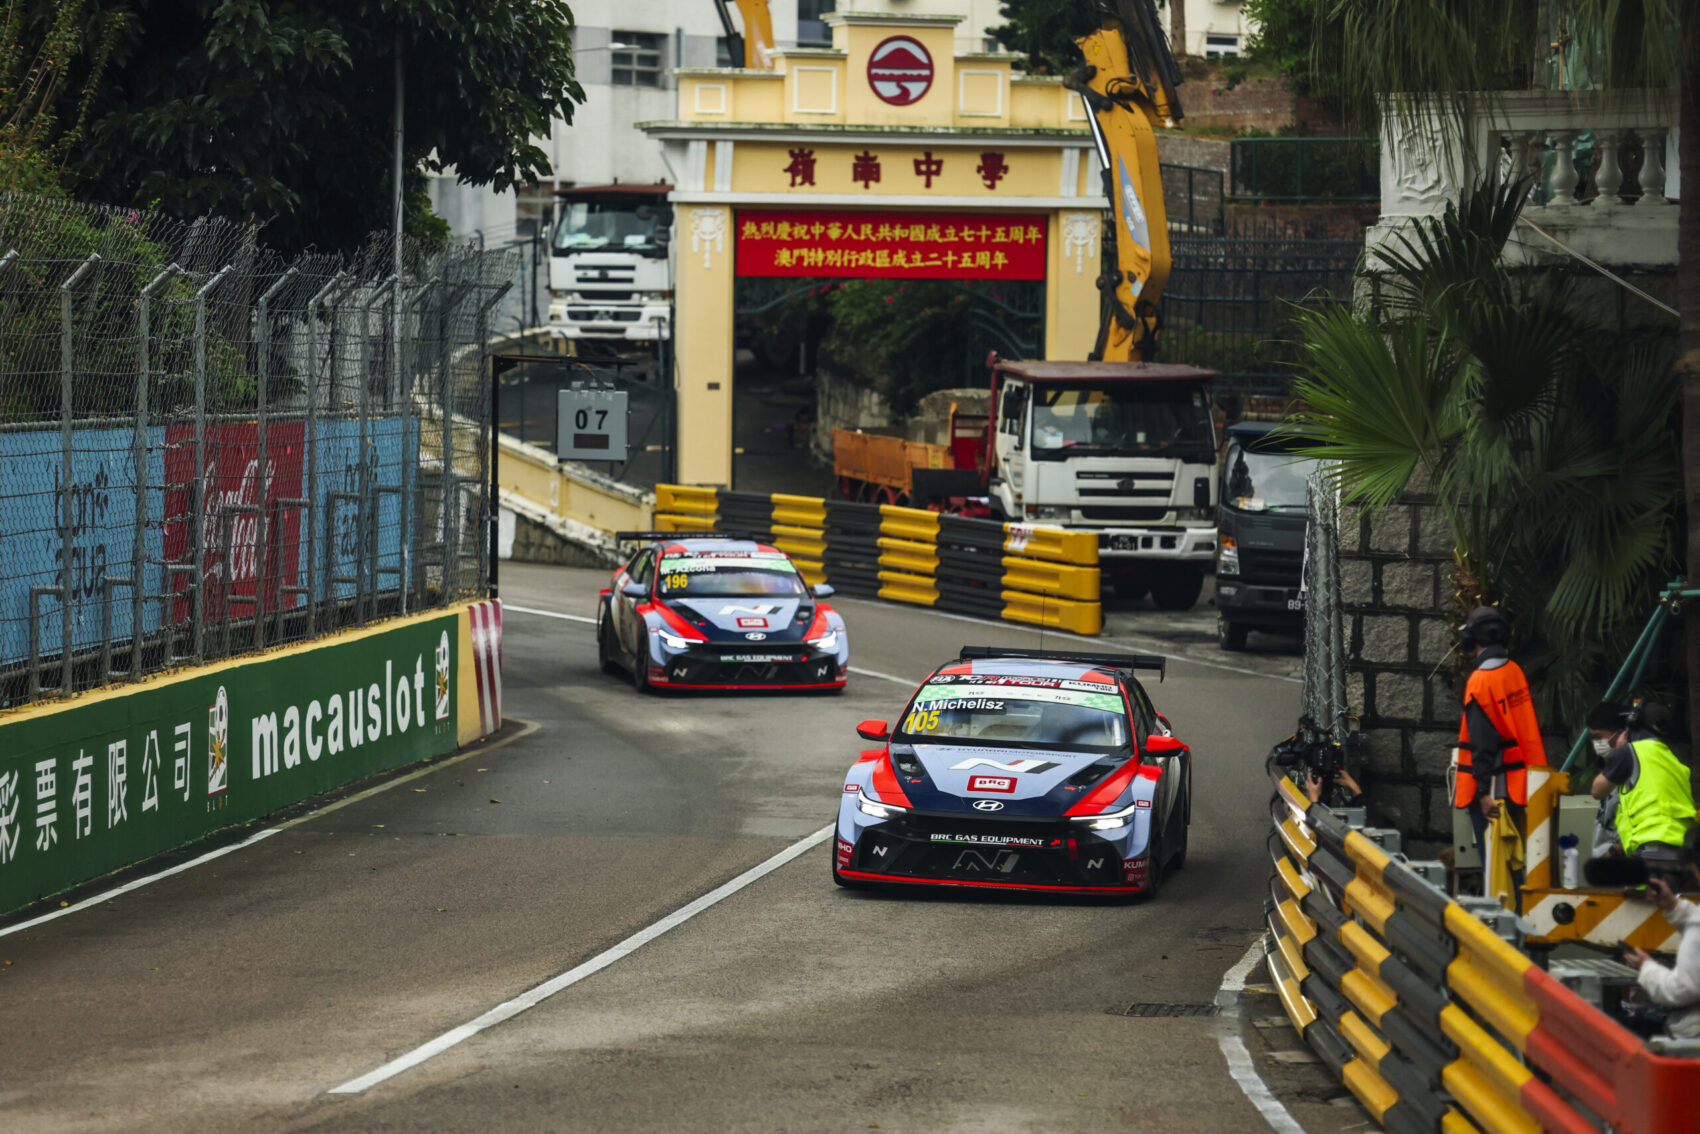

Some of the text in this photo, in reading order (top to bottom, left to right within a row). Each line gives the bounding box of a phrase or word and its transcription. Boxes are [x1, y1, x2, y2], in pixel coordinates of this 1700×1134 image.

[783, 147, 1009, 190] 嶺南中學
[774, 247, 1008, 270] 澳門特別行政區成立二十五周年
[575, 409, 608, 430] 07
[665, 573, 688, 589] 196
[252, 653, 425, 779] macauslot
[906, 710, 941, 733] 105
[0, 722, 191, 865] 彩票有限公司
[930, 833, 952, 841] BRC
[981, 835, 1044, 845] EQUIPMENT
